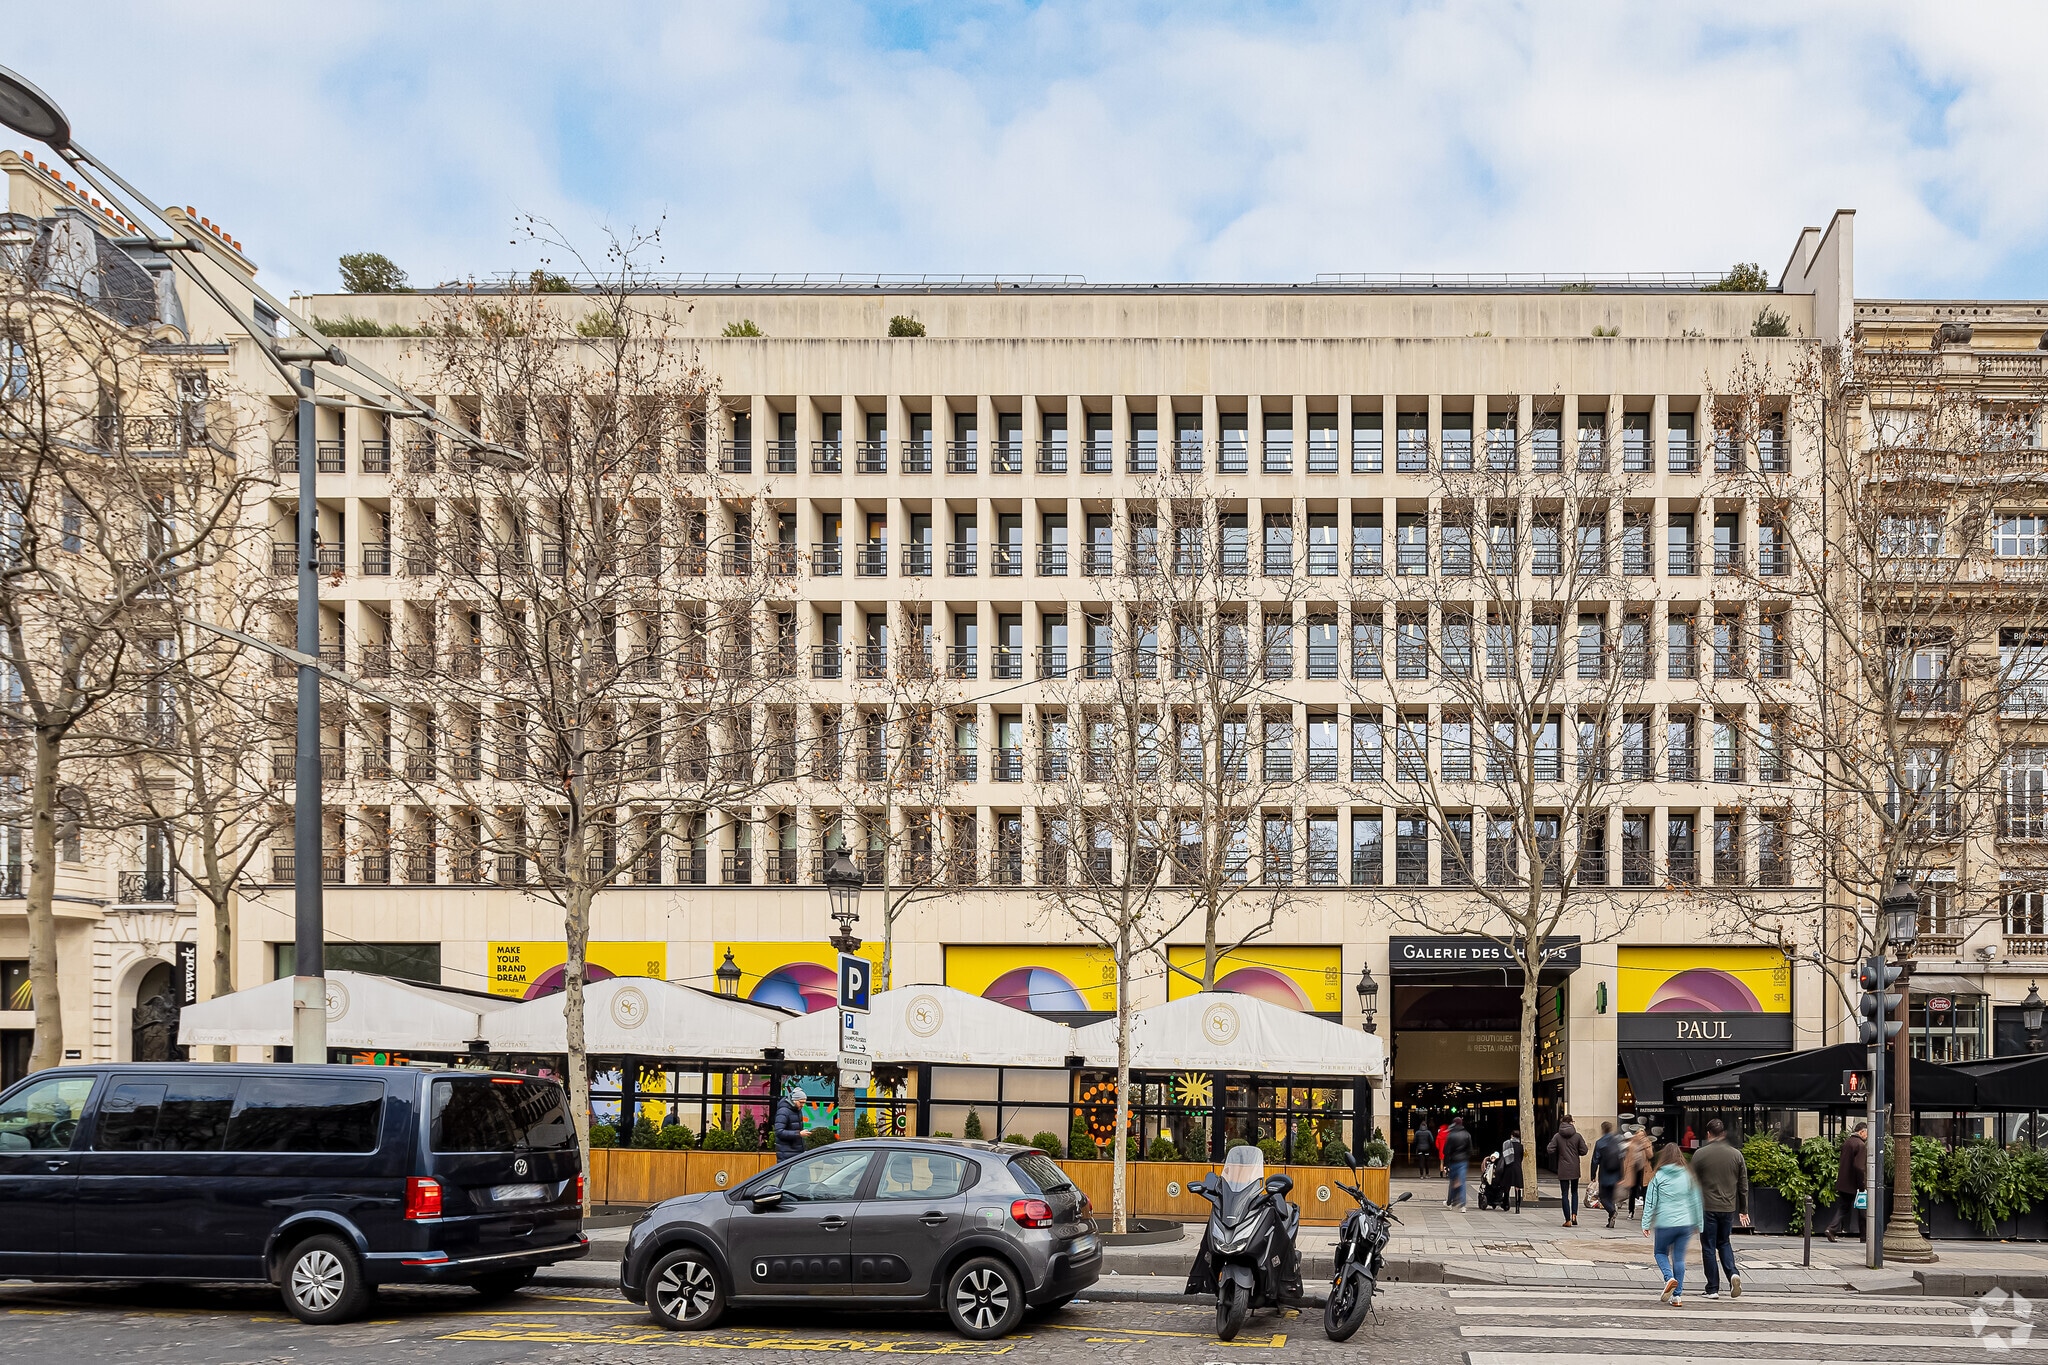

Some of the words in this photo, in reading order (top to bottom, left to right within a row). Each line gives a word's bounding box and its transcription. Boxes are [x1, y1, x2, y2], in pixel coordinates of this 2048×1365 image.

[497, 946, 521, 954] MAKE
[1403, 944, 1467, 959] GALERIE
[1471, 947, 1500, 959] DES
[1504, 945, 1567, 960] CHMPS
[497, 955, 520, 963] YOUR
[181, 947, 196, 1003] wework
[497, 964, 526, 972] BRAND
[497, 974, 526, 982] DREAM
[848, 966, 862, 1000] P
[620, 999, 638, 1016] 86
[847, 1015, 852, 1027] P
[915, 1007, 933, 1025] 86
[1211, 1015, 1230, 1033] 86
[1476, 1034, 1513, 1042] BOUTIQUES
[1676, 1020, 1733, 1040] PAUL
